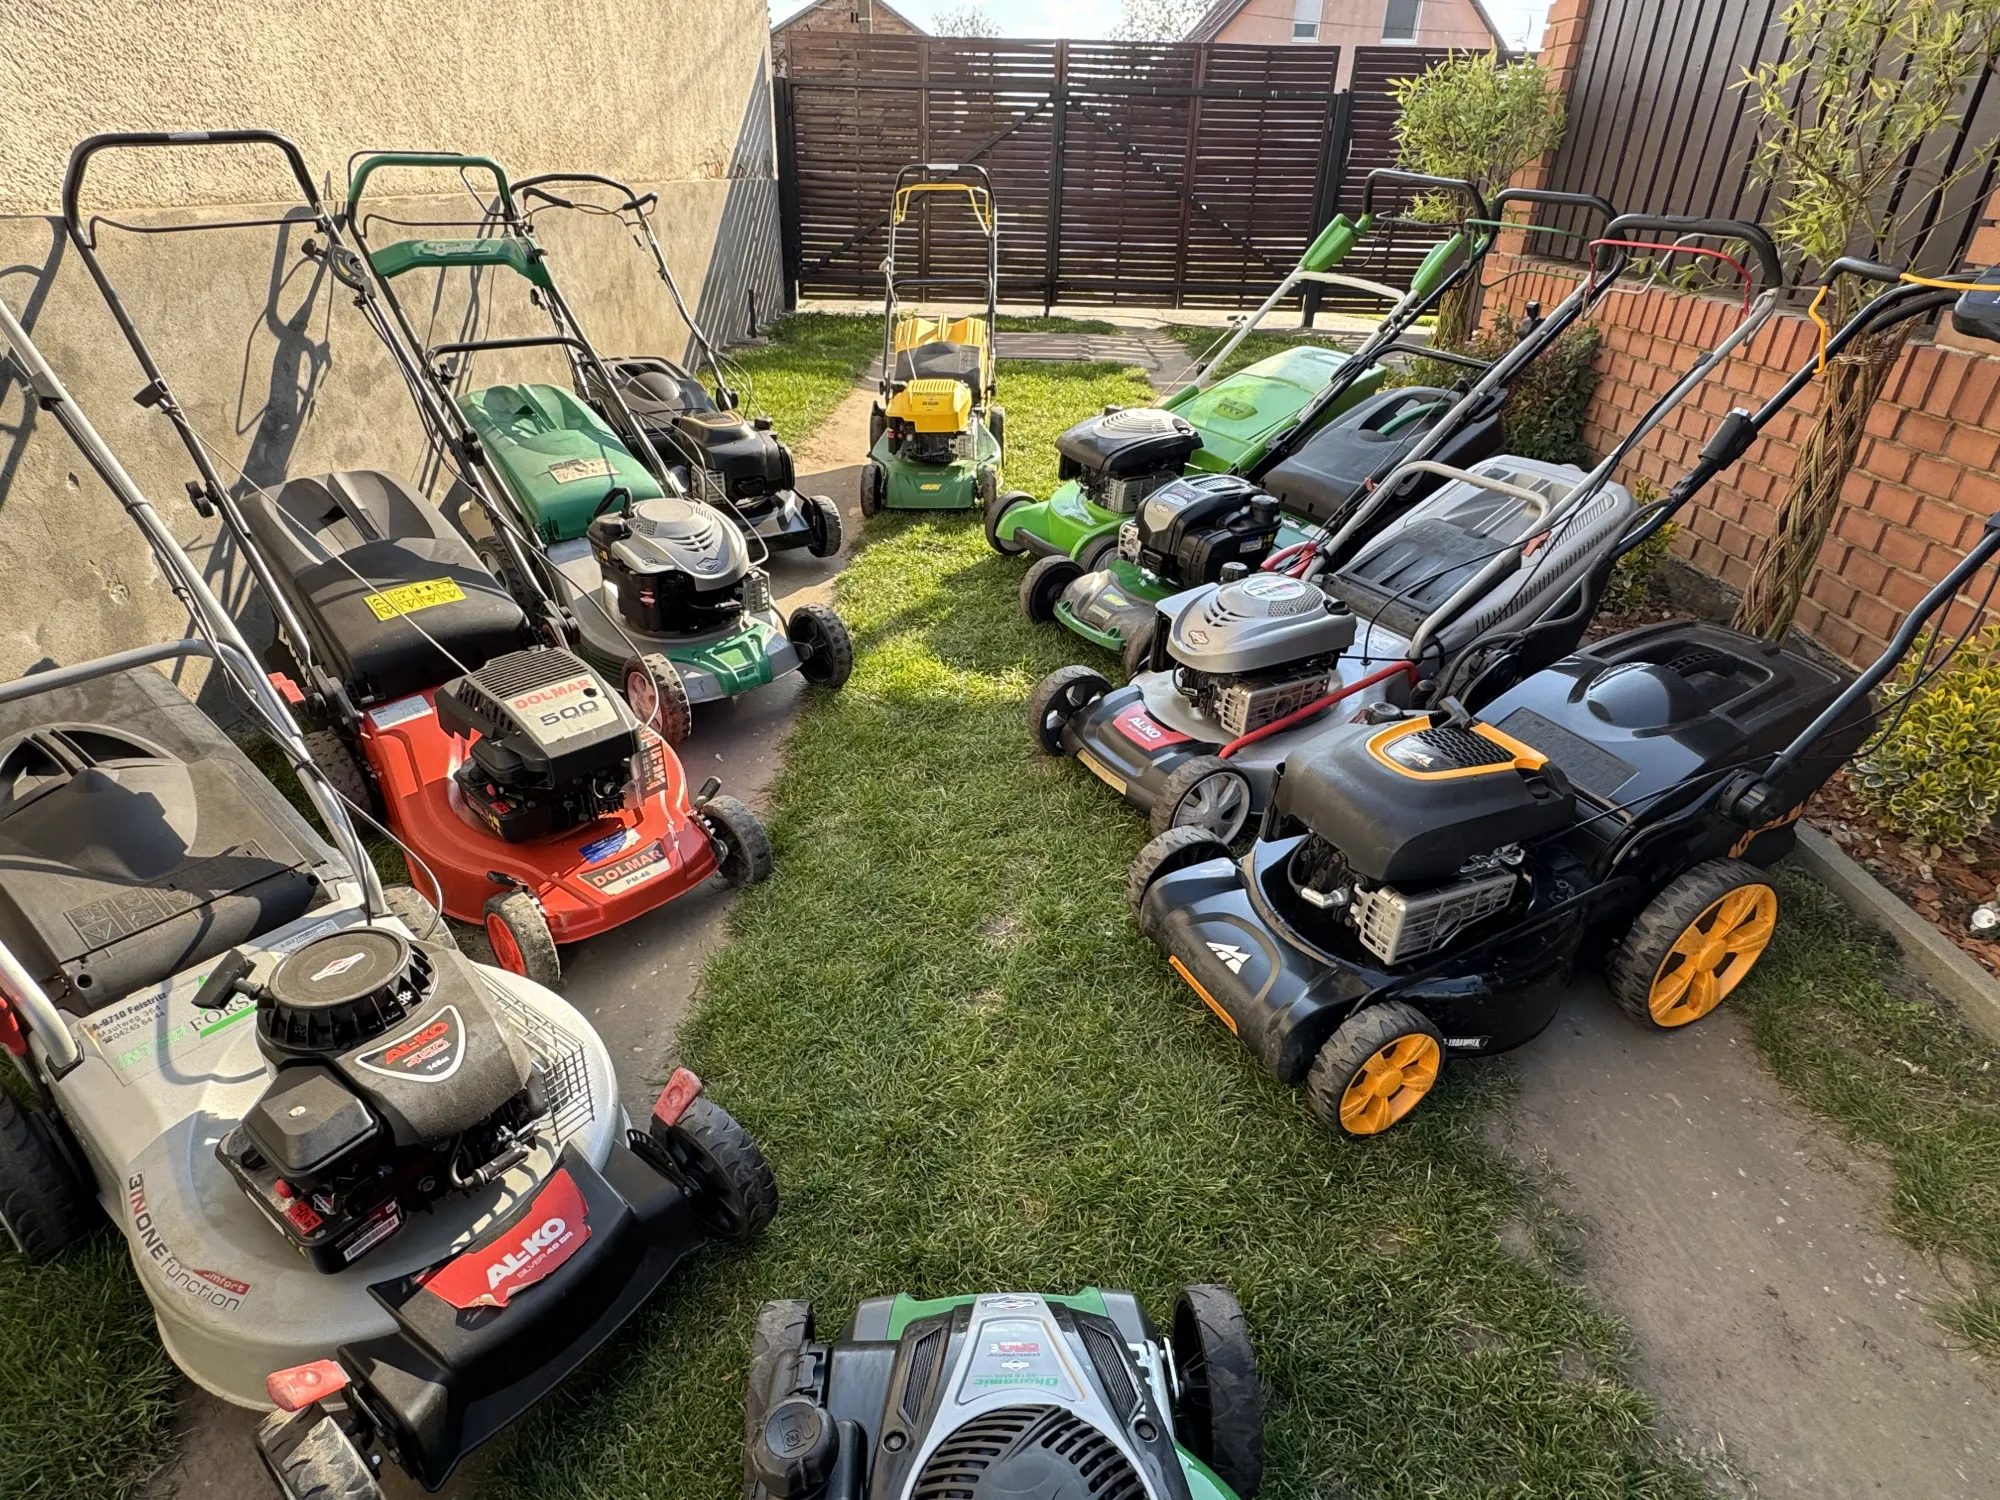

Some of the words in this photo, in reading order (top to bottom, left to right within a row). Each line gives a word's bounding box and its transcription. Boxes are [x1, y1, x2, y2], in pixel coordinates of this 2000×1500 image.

[514, 679, 592, 710] DOLMAR
[540, 700, 599, 726] 500
[1127, 717, 1162, 738] AL-KO
[592, 849, 664, 887] DOLMAR
[92, 1010, 127, 1031] A-9710
[127, 992, 168, 1014] Feistritz
[97, 1015, 141, 1038] Mautweg
[141, 1017, 153, 1026] 64
[155, 1011, 166, 1019] 44
[189, 995, 251, 1032] FORS
[385, 1022, 449, 1065] AL-KO
[486, 1217, 566, 1291] AL-KO
